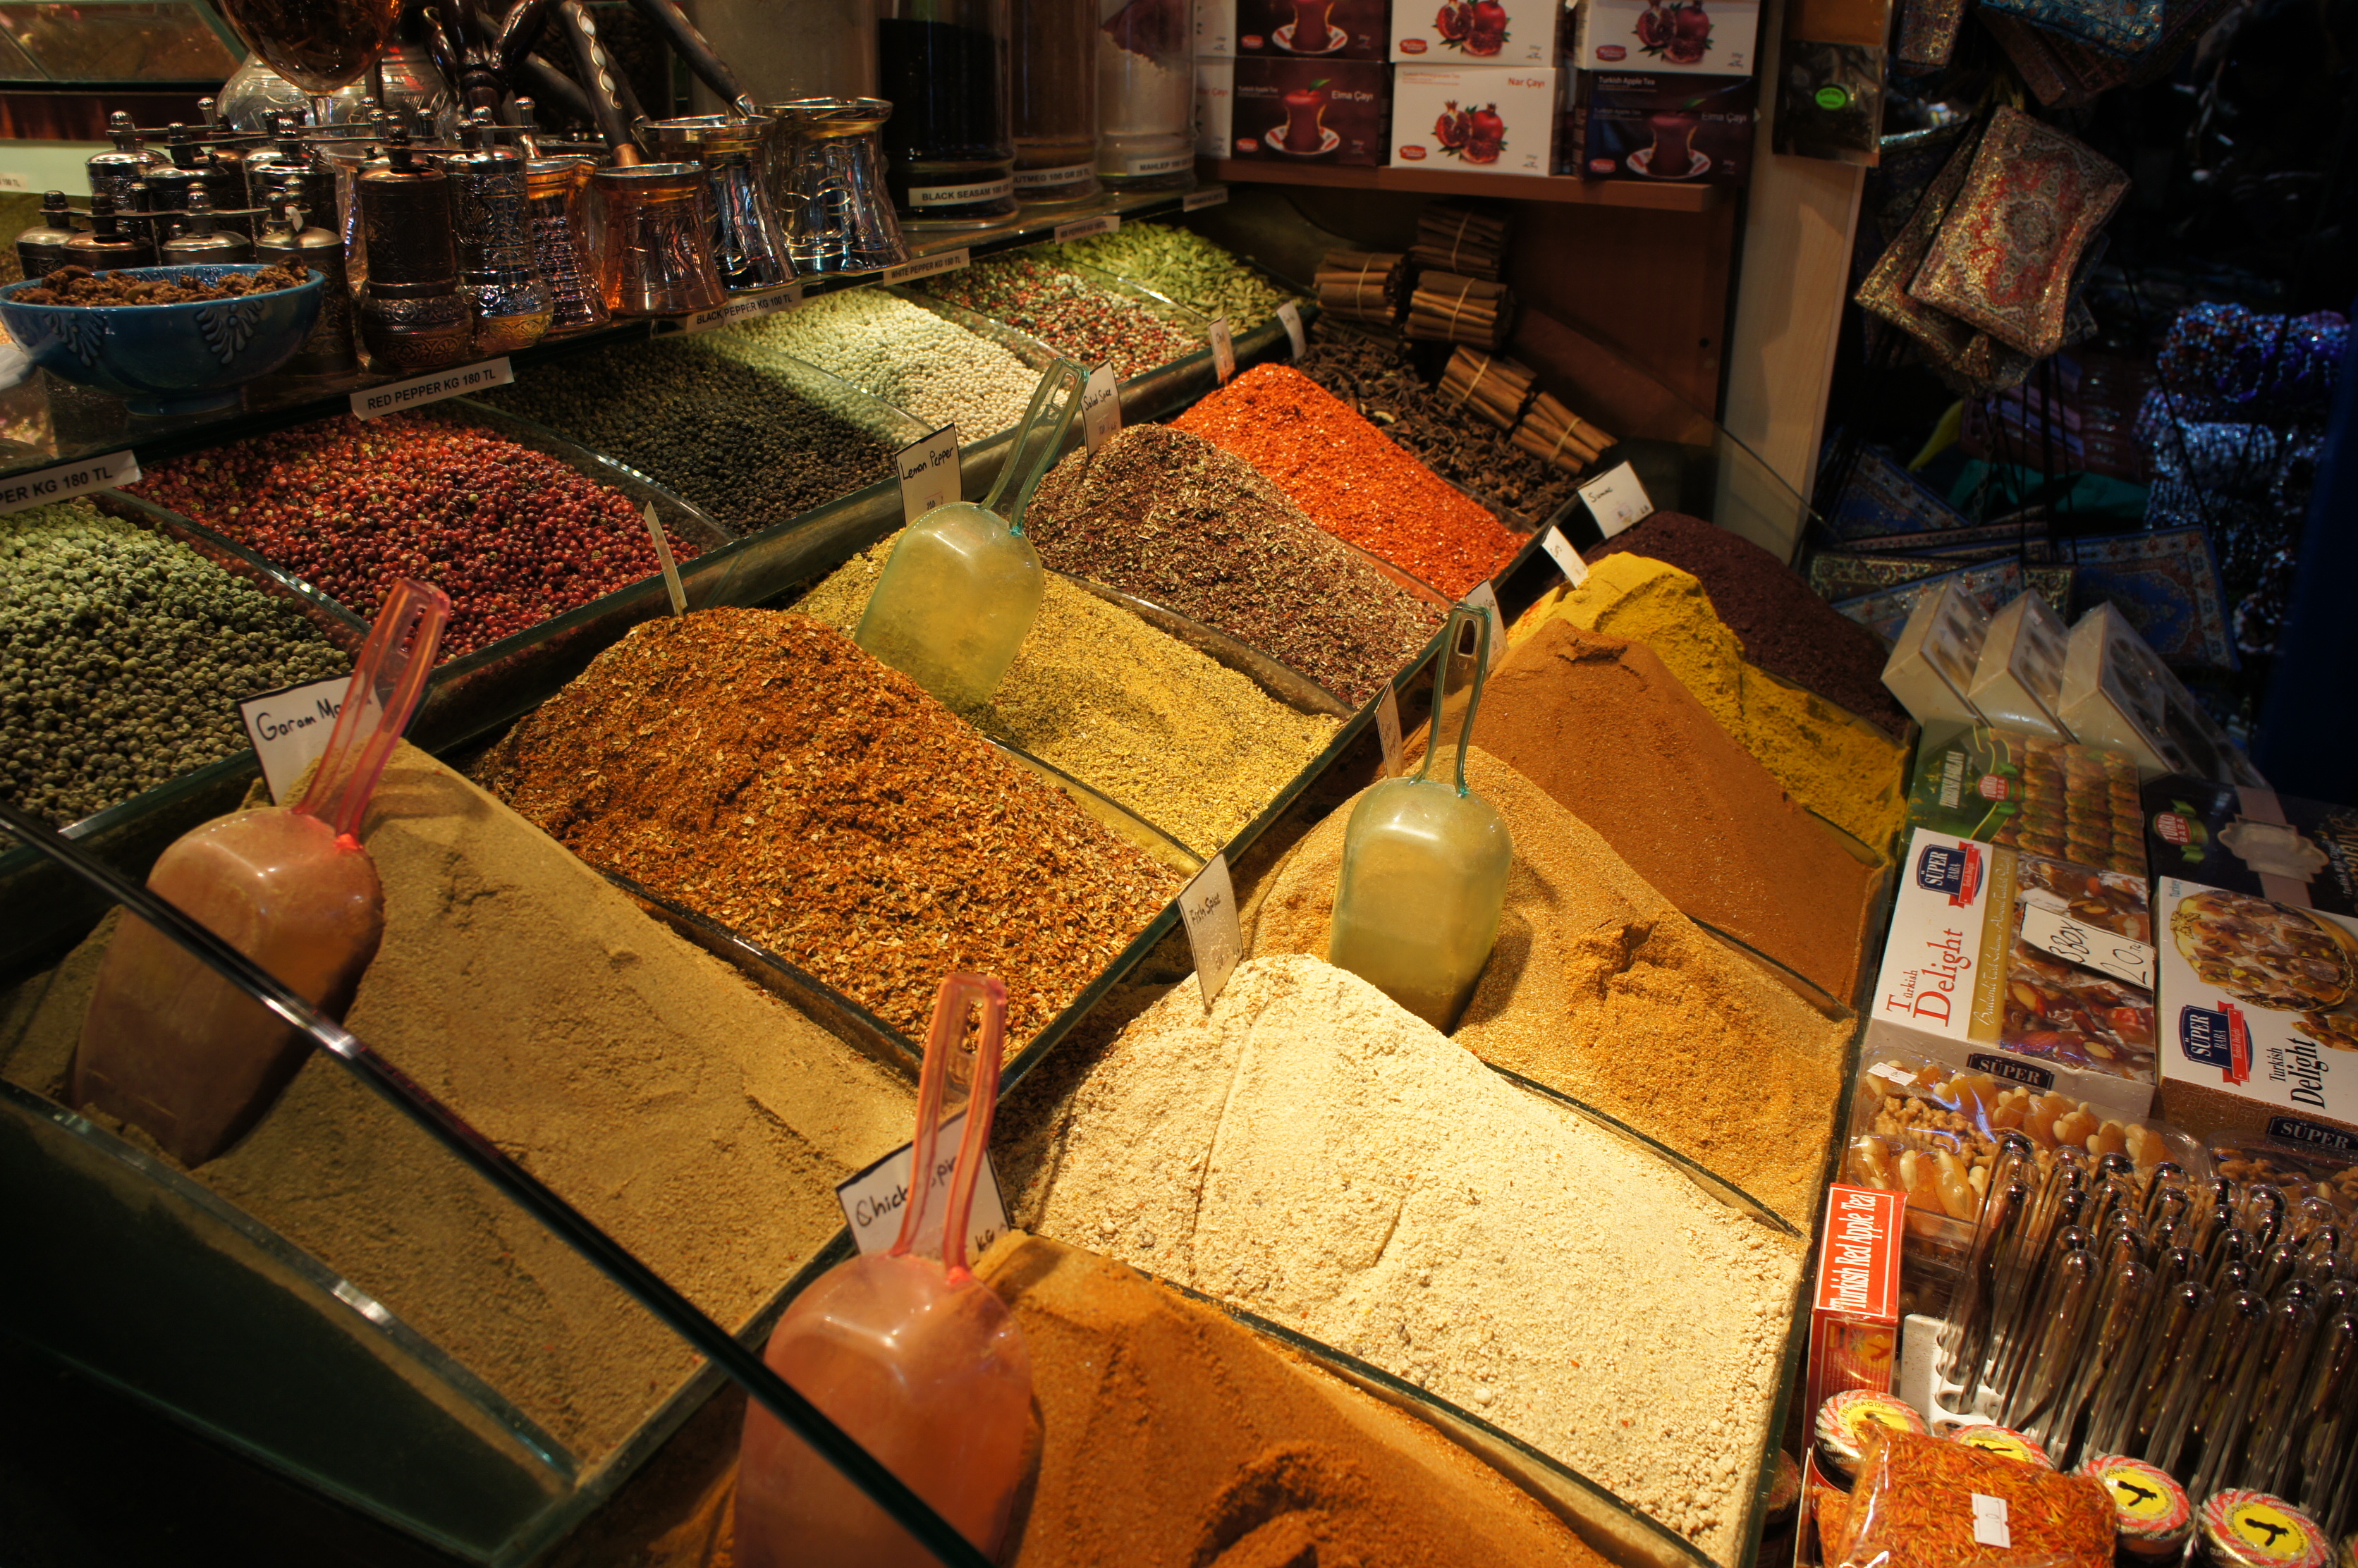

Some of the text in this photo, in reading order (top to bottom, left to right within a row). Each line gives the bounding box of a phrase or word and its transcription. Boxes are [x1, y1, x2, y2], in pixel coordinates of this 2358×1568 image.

[1331, 90, 1352, 100] Elma
[1508, 77, 1524, 86] Nar
[1598, 75, 1656, 87] Turkish Apple Tea
[1701, 111, 1724, 121] Elma
[922, 192, 955, 201] BLACK
[957, 188, 991, 199] SEASAM
[891, 267, 910, 279] WHITE
[910, 261, 934, 274] PEPPER
[934, 259, 944, 269] KG
[953, 255, 961, 264] TL
[696, 293, 793, 325] BLACK PEPPER KG 100 TL
[367, 368, 496, 410] RED PEPPER KG 180 TL
[1083, 393, 1099, 411] Salad
[900, 446, 954, 481] Lemon Pepper
[32, 479, 58, 497] KG
[62, 471, 89, 489] 180
[92, 467, 113, 482] TL
[256, 711, 317, 742] Garam
[2158, 814, 2179, 841] TURKO
[2176, 817, 2188, 843] BABA
[1920, 851, 1948, 886] SÜPER
[1188, 903, 1206, 926] Fish
[1912, 927, 1972, 1028] Delight
[2184, 1013, 2210, 1058] SÜPER
[2213, 1029, 2228, 1051] BABA
[2232, 1027, 2244, 1060] Turkish Delight
[1978, 1058, 2041, 1085] SÜPER
[2266, 1046, 2287, 1083] Turkish
[2285, 1036, 2330, 1110] Delight
[2280, 1121, 2350, 1150] SÜPER
[1840, 1193, 1876, 1213] Tea
[1837, 1212, 1883, 1246] Apple
[1834, 1242, 1871, 1268] Red
[1829, 1267, 1869, 1309] Turkish
